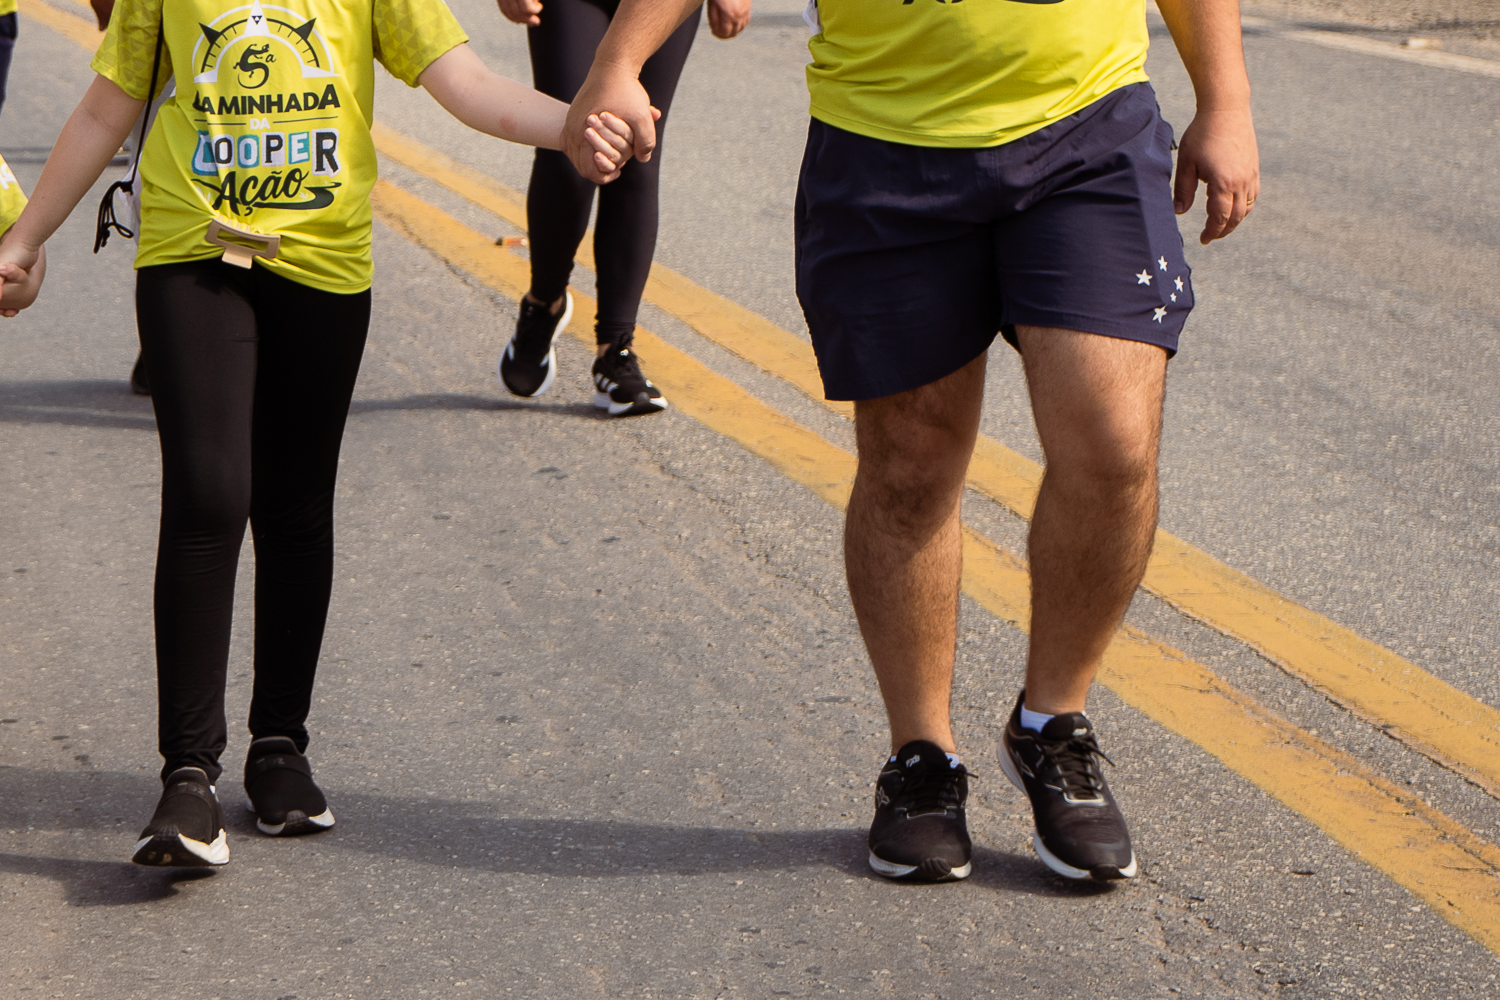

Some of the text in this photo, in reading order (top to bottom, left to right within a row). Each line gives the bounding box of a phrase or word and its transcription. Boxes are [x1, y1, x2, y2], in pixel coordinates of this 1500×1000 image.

[250, 117, 270, 130] DA
[193, 131, 340, 176] COOPER
[194, 167, 310, 217] Ação
